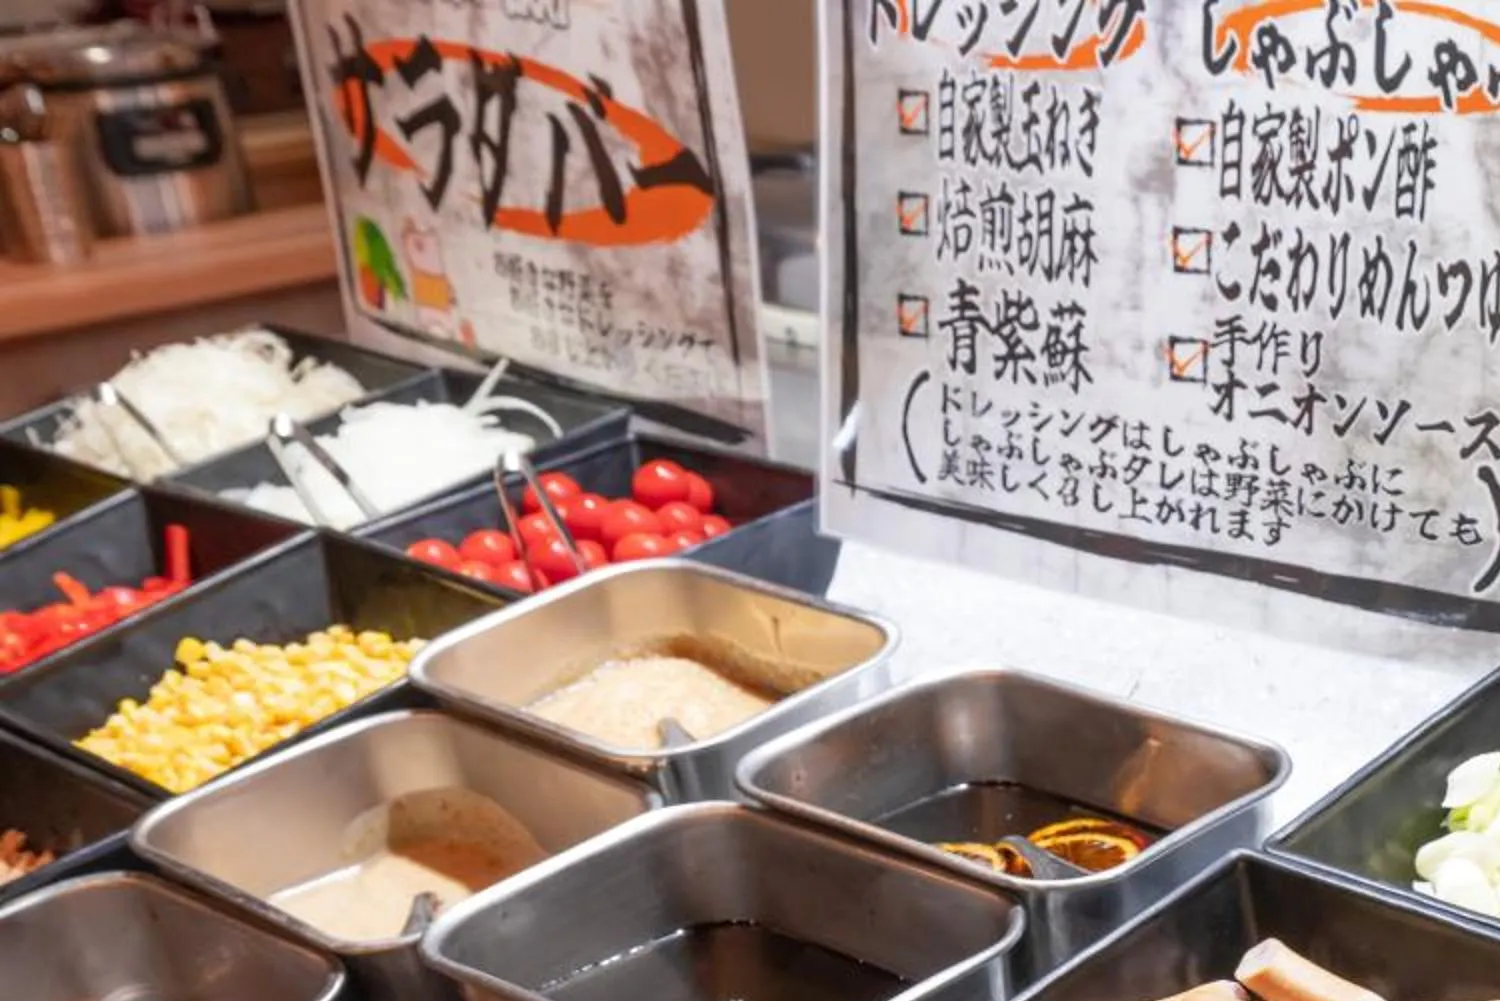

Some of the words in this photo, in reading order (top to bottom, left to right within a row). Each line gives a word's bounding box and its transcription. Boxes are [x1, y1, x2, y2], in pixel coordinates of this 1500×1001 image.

[326, 12, 714, 237] サラダバー
[938, 68, 1101, 177] 自家製玉ねぎ
[1219, 99, 1438, 223] 自家製ポン酢
[936, 178, 1099, 288] 焙煎胡麻
[938, 278, 1093, 395] 青紫蘇
[1209, 315, 1323, 378] 手作り
[941, 383, 1405, 495] ドレッシングはしゃぶしゃぶに
[937, 451, 1292, 547] 美味しく召し上がれます
